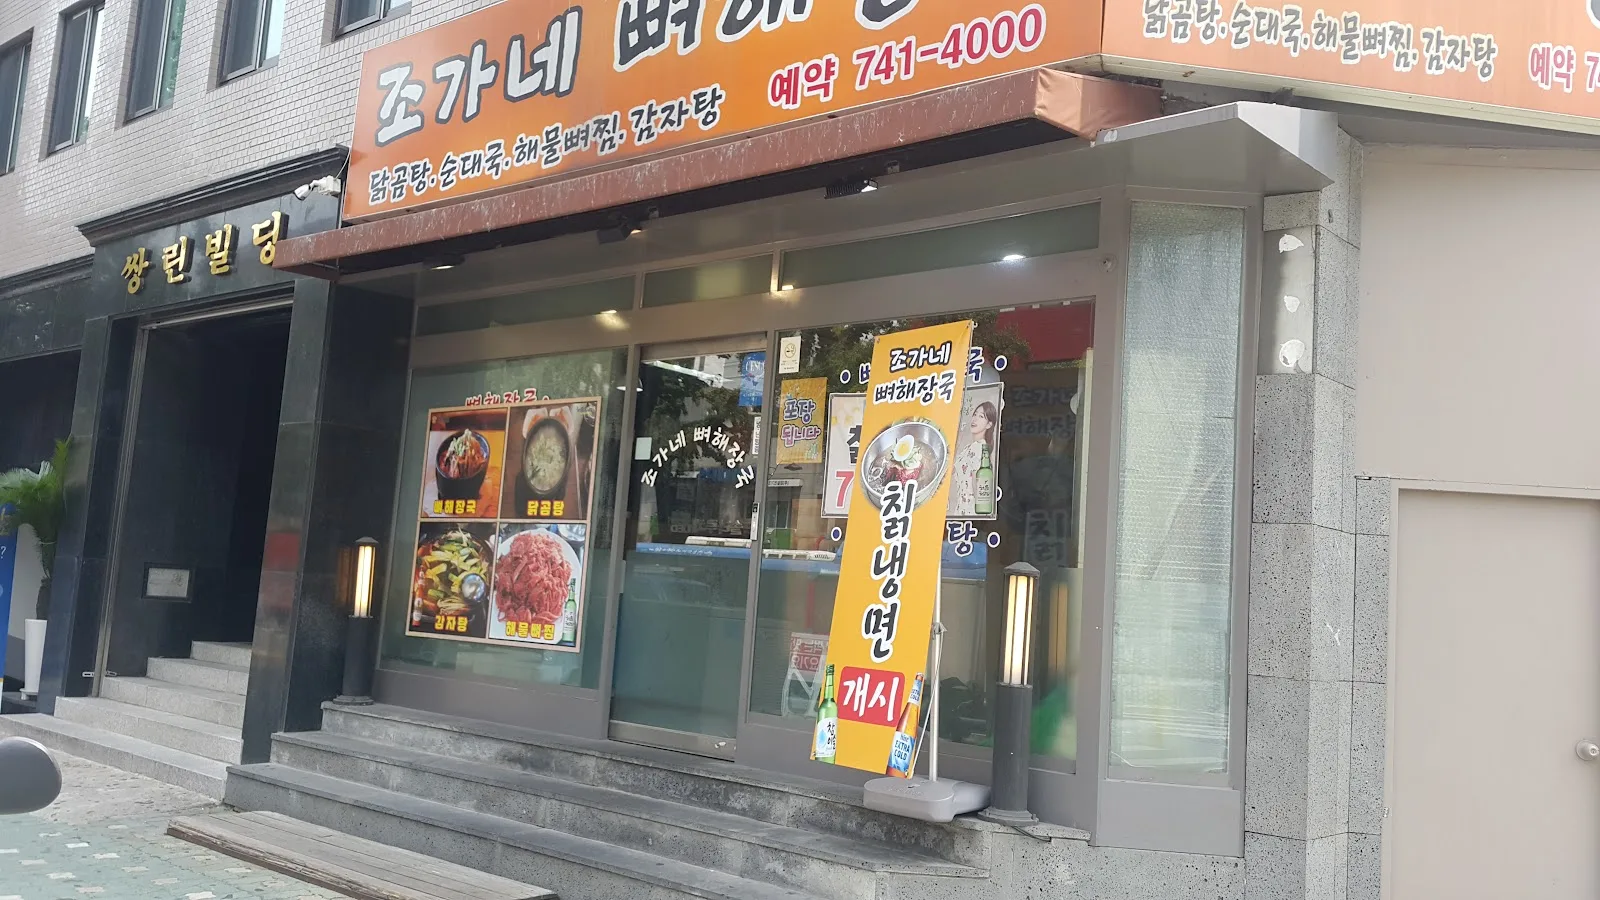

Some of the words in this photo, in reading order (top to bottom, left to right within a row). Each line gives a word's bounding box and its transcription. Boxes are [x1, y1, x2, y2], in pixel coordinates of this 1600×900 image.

[770, 58, 838, 107] 예약
[855, 8, 1044, 88] 741-4000
[1529, 46, 1575, 91] 예약
[1586, 54, 1600, 90] 7
[373, 6, 584, 147] 조가네
[890, 341, 952, 373] 조가네
[874, 370, 956, 405] 뼈해장국
[783, 398, 816, 425] 포장
[780, 424, 822, 448] 됩니다
[640, 429, 687, 488] 조가네
[692, 425, 755, 490] 뼈해장국
[864, 482, 915, 660] 칡냉면
[434, 614, 469, 633] 감자탕
[842, 672, 900, 722] 개시
[894, 740, 911, 754] EXTRA
[894, 749, 908, 761] COLD
